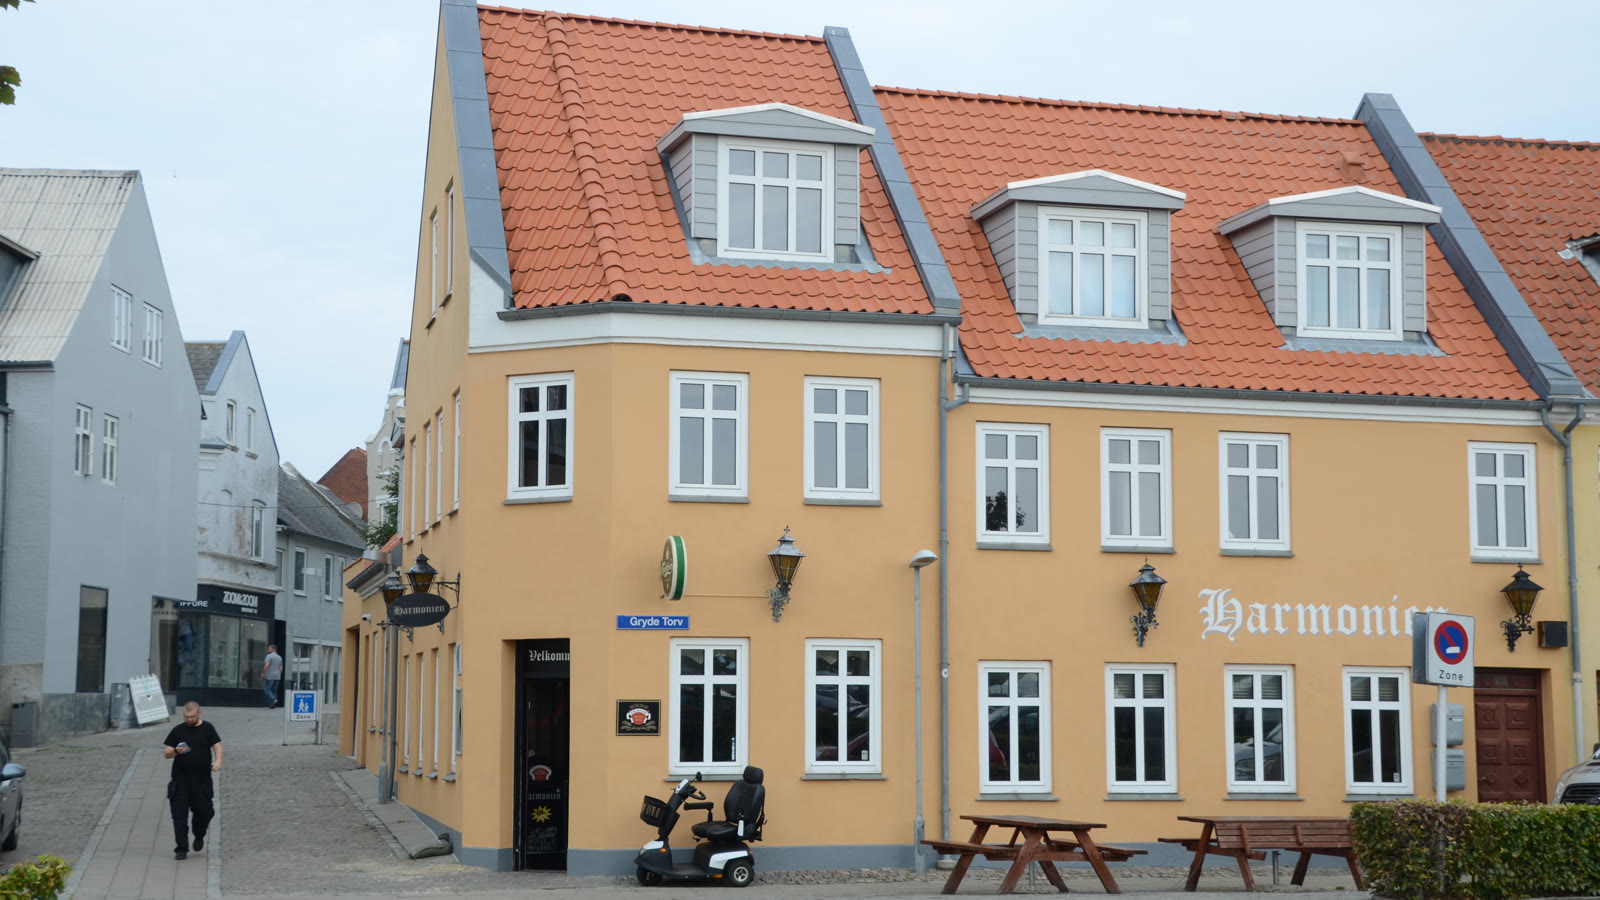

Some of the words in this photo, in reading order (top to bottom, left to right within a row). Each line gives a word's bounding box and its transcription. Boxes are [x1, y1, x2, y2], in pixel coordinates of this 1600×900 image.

[394, 604, 446, 616] Harmonien
[1198, 588, 1450, 642] Harmonie
[629, 616, 660, 628] Gryde
[661, 616, 684, 627] Torv
[1438, 669, 1464, 682] Zone
